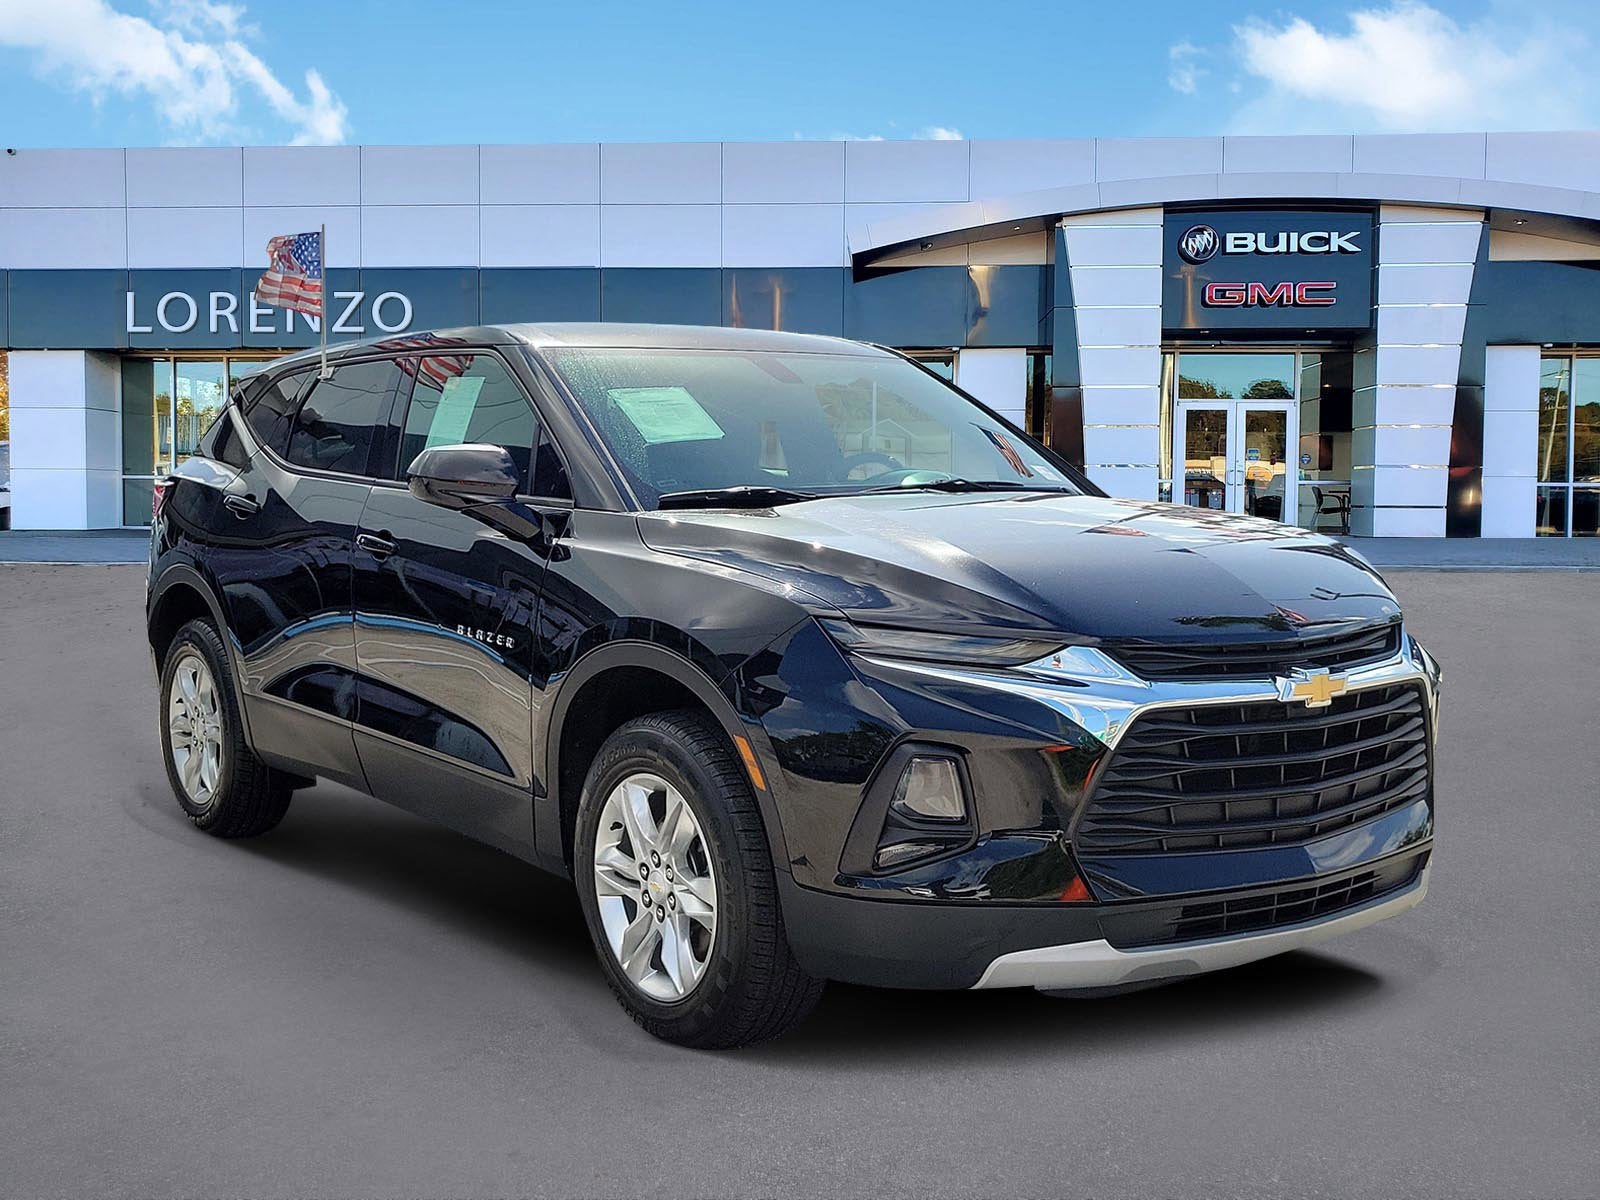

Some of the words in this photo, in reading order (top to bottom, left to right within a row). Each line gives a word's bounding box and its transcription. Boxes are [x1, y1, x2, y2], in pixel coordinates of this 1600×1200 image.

[1226, 231, 1361, 252] BUICK
[1205, 282, 1337, 305] GMC
[457, 624, 514, 648] BLAZER
